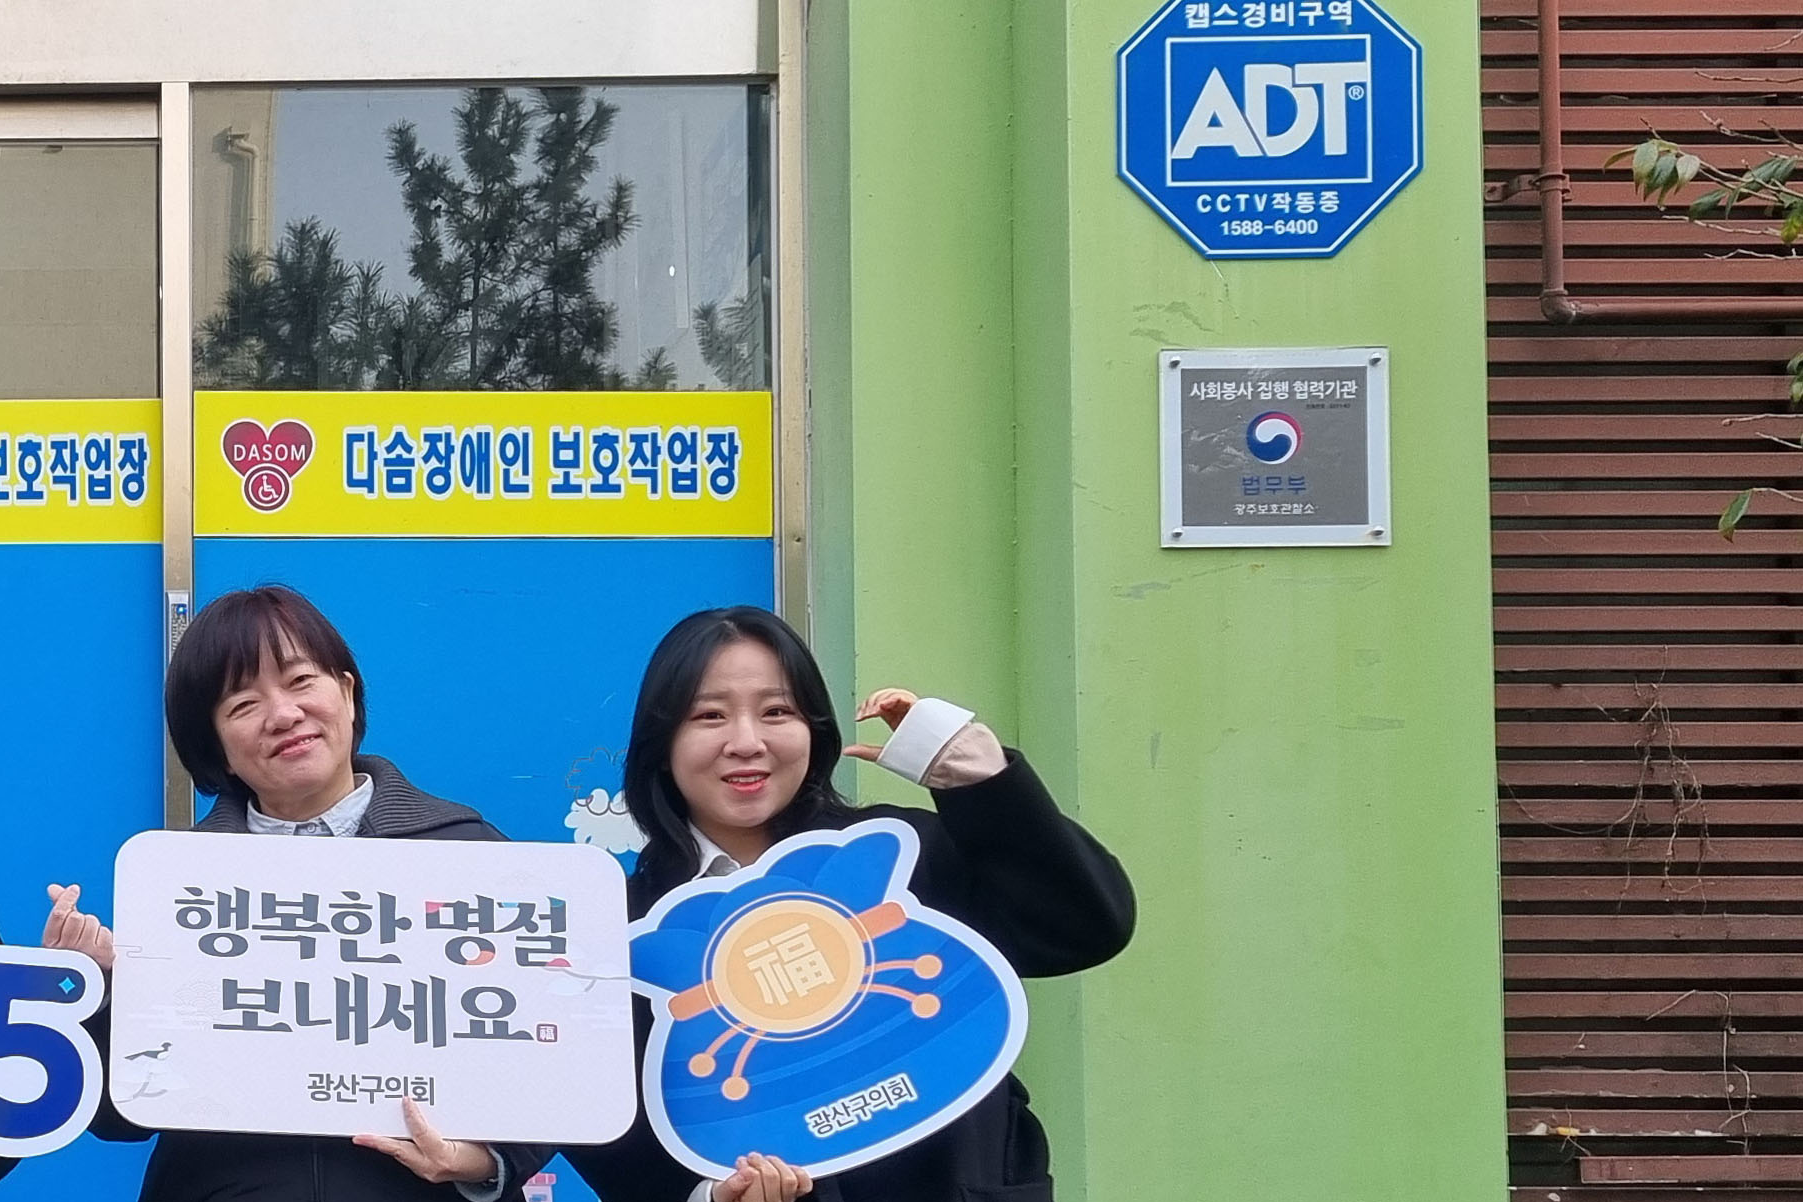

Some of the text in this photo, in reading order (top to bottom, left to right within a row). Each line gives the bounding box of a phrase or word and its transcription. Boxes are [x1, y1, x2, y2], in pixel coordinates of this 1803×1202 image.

[1185, 2, 1353, 28] 캡스경비구역
[1197, 191, 1339, 214] CCTV작동중
[1219, 220, 1318, 236] 1588-6400
[1190, 380, 1358, 400] 사회봉사 집행 협력기관
[233, 443, 307, 462] DASOM
[346, 430, 740, 494] 다솜장애인 보호작업장
[1242, 476, 1306, 496] 법무부
[174, 886, 572, 967] 행복한 명절
[742, 923, 837, 1006] 福
[213, 973, 534, 1048] 보내세요
[307, 1073, 436, 1105] 광산구의회
[808, 1076, 914, 1135] 광산구의회
